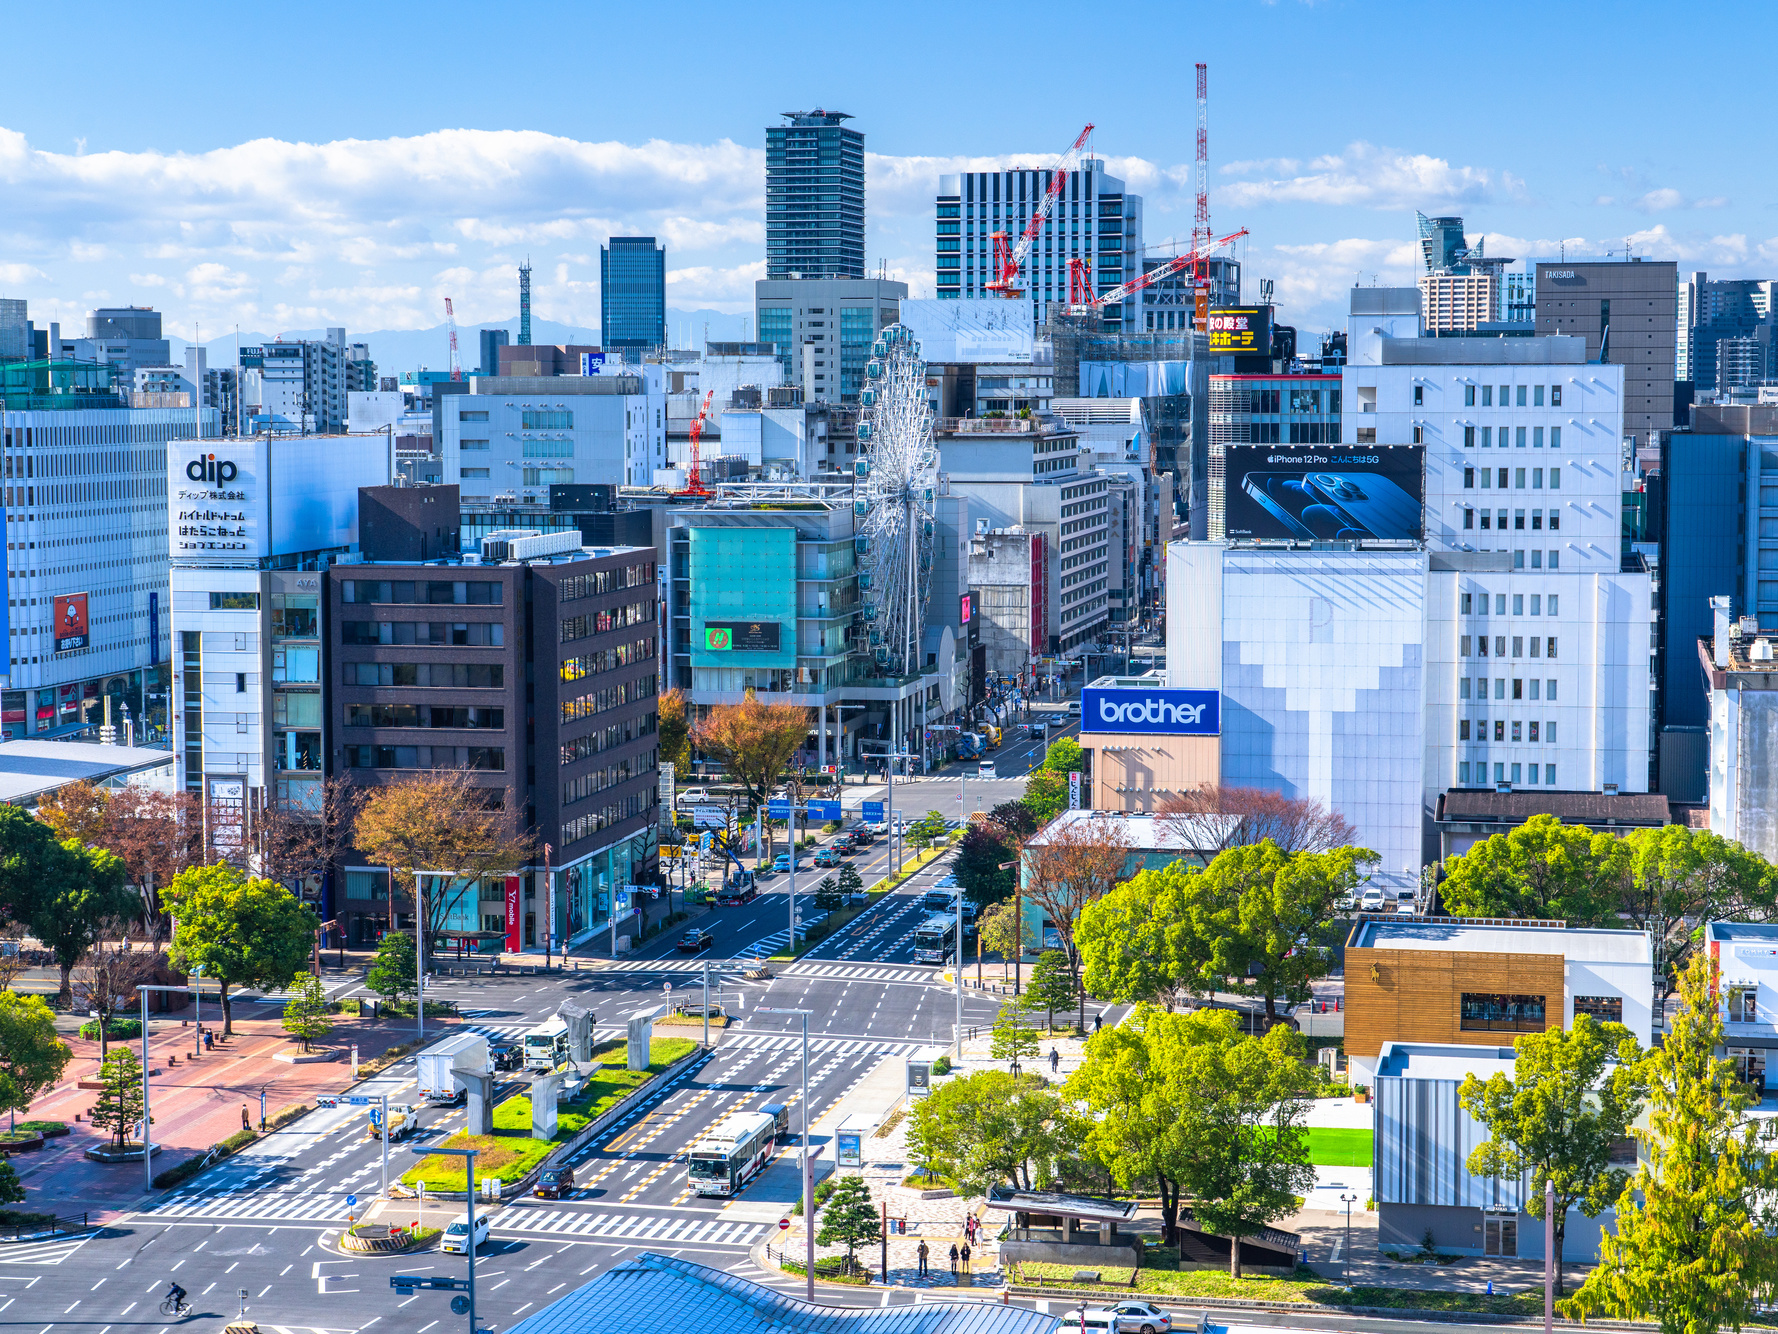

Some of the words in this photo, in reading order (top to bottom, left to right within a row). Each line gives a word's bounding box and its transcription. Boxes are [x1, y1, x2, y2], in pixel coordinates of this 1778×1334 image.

[1545, 271, 1575, 279] TAKISADA
[1274, 455, 1303, 464] iPhone
[1303, 455, 1313, 464] 12
[1314, 455, 1328, 464] Pro
[1331, 455, 1380, 464] こんにちは5G
[186, 453, 238, 489] dip
[178, 490, 245, 500] ディップ株式会社
[179, 510, 245, 521] バイトルドットコム
[179, 525, 246, 537] はたらこねっと
[179, 541, 246, 550] ジョブエンジン
[1099, 697, 1206, 724] brother
[1070, 781, 1078, 809] じゃんじゃん
[508, 889, 517, 926] Y!mobile
